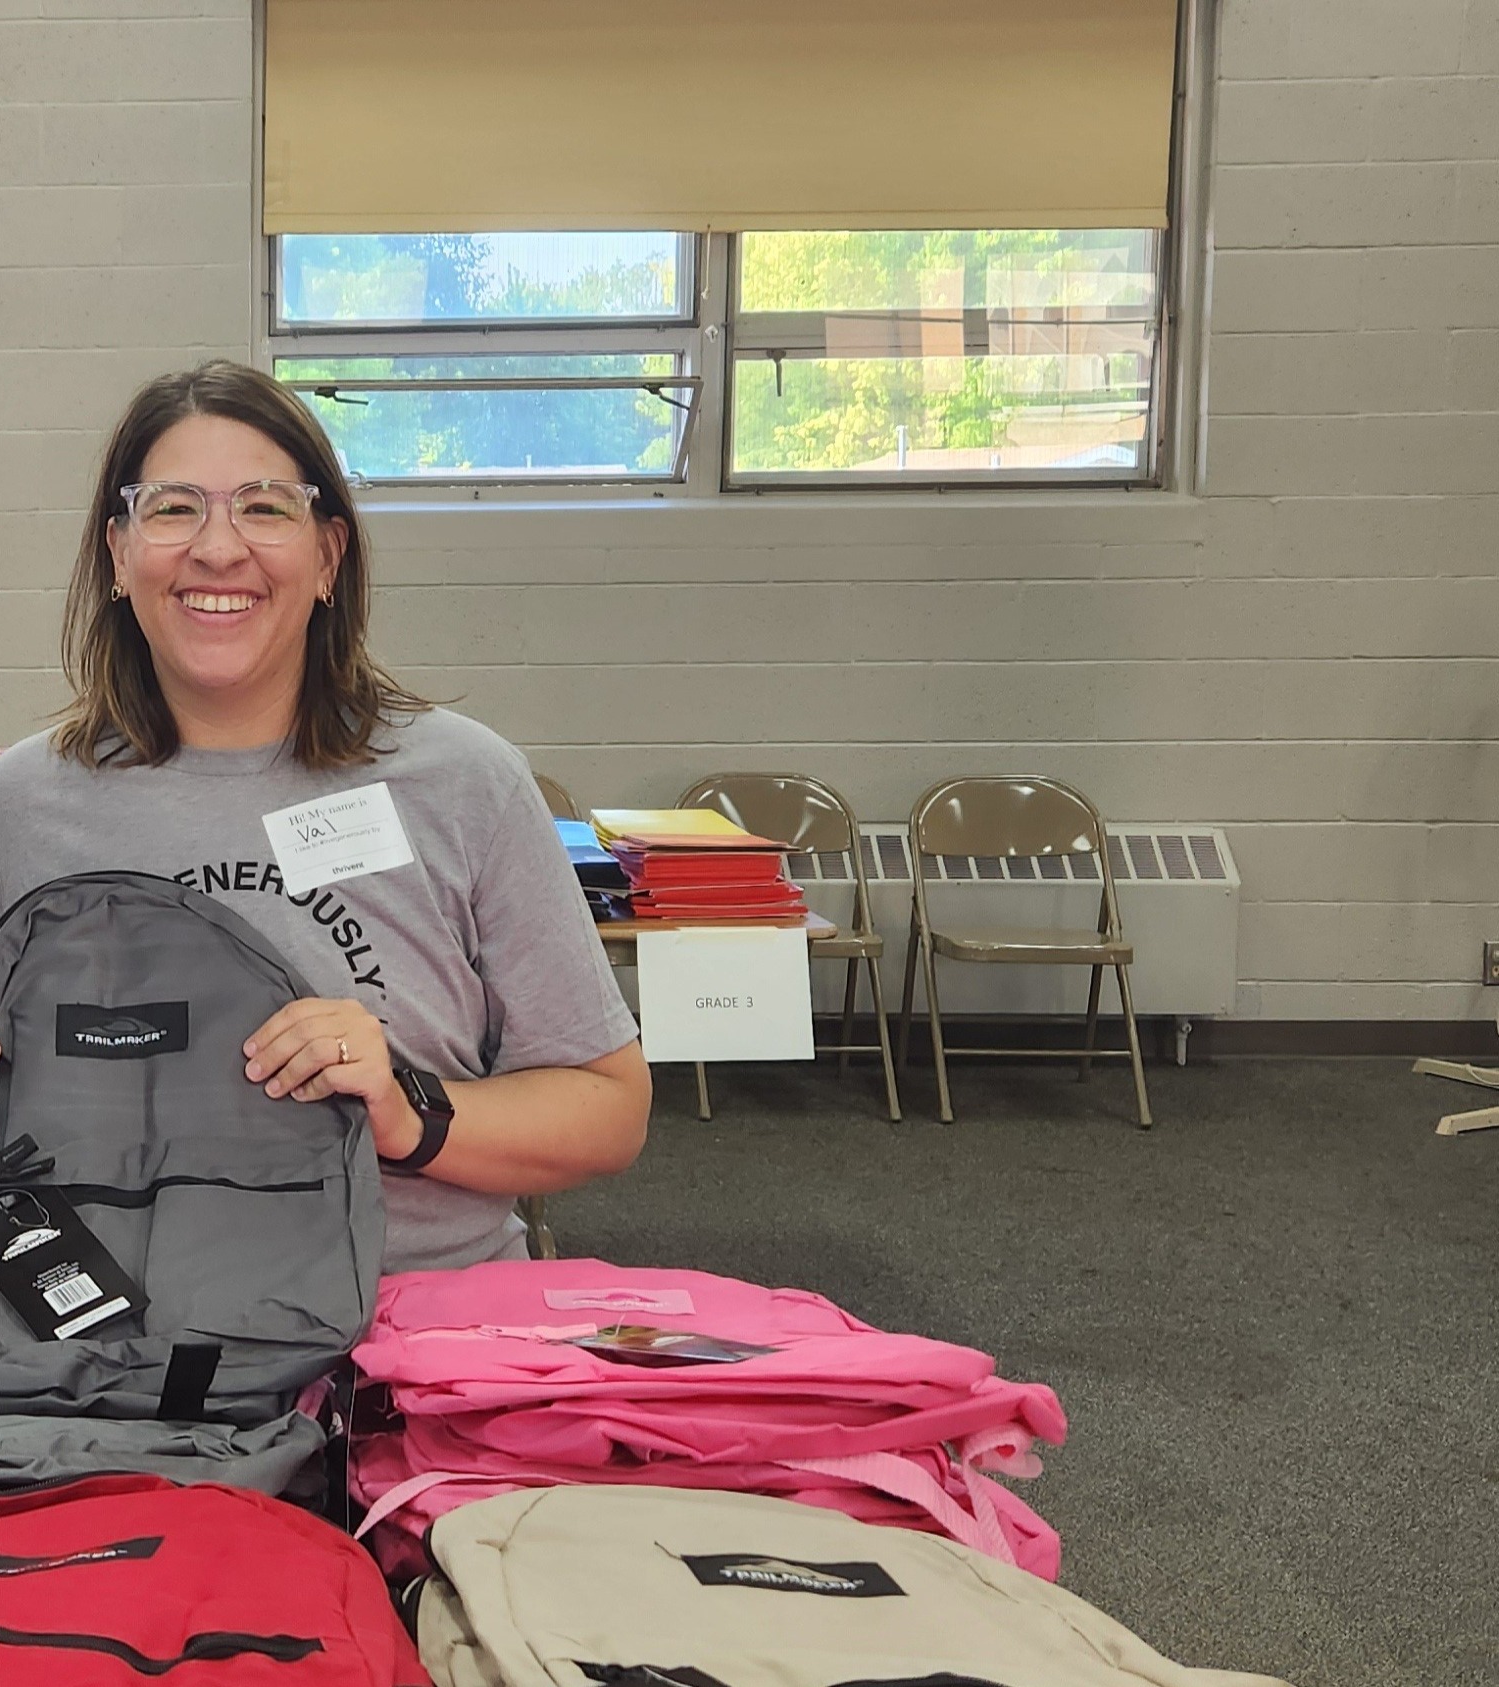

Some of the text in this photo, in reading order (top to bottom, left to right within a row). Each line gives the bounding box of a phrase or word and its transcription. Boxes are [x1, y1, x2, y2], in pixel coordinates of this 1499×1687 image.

[288, 798, 367, 826] Hi! My name is
[297, 818, 337, 843] Val
[332, 862, 365, 875] thrivent
[695, 996, 754, 1009] GRADE 3
[75, 1032, 161, 1046] TRAILMAKER
